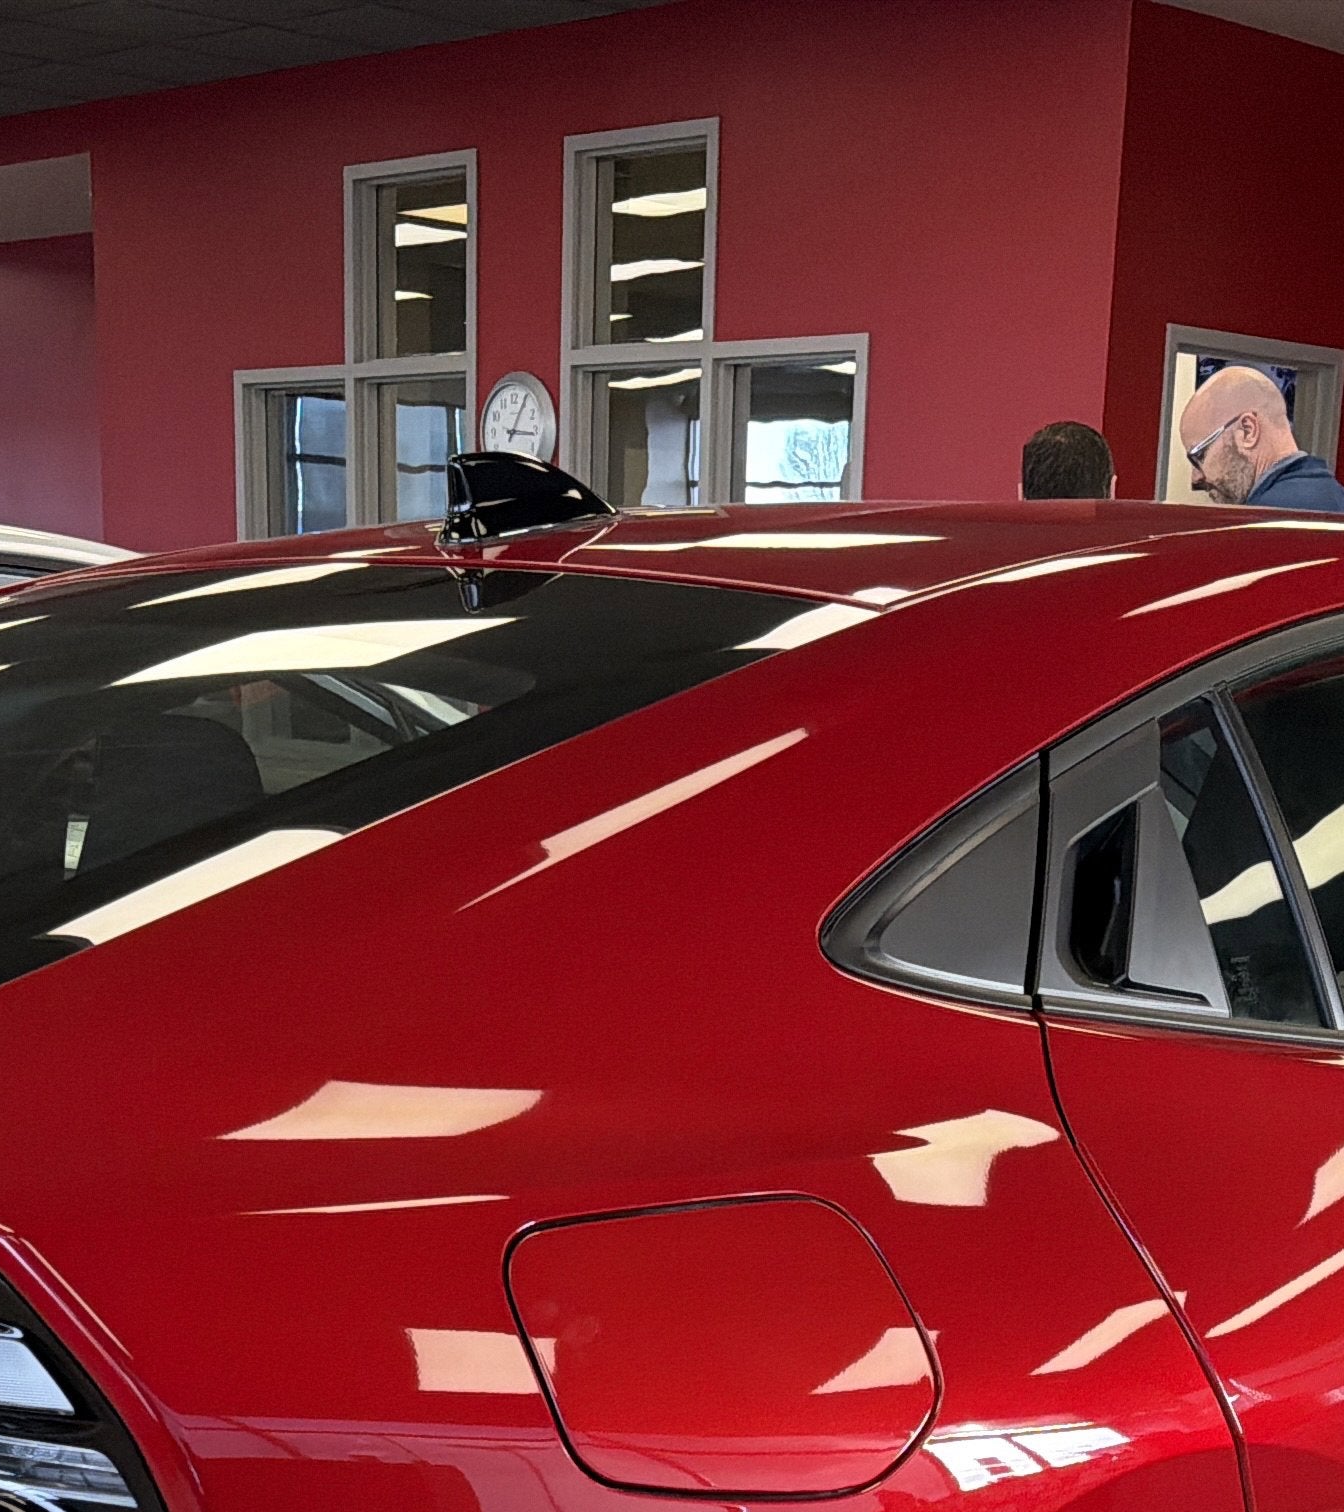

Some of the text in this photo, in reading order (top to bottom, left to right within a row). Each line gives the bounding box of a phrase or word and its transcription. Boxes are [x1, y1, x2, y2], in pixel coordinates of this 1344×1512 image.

[500, 399, 507, 409] 11
[510, 393, 518, 404] 12
[493, 410, 500, 422] 10
[529, 408, 535, 420] 2
